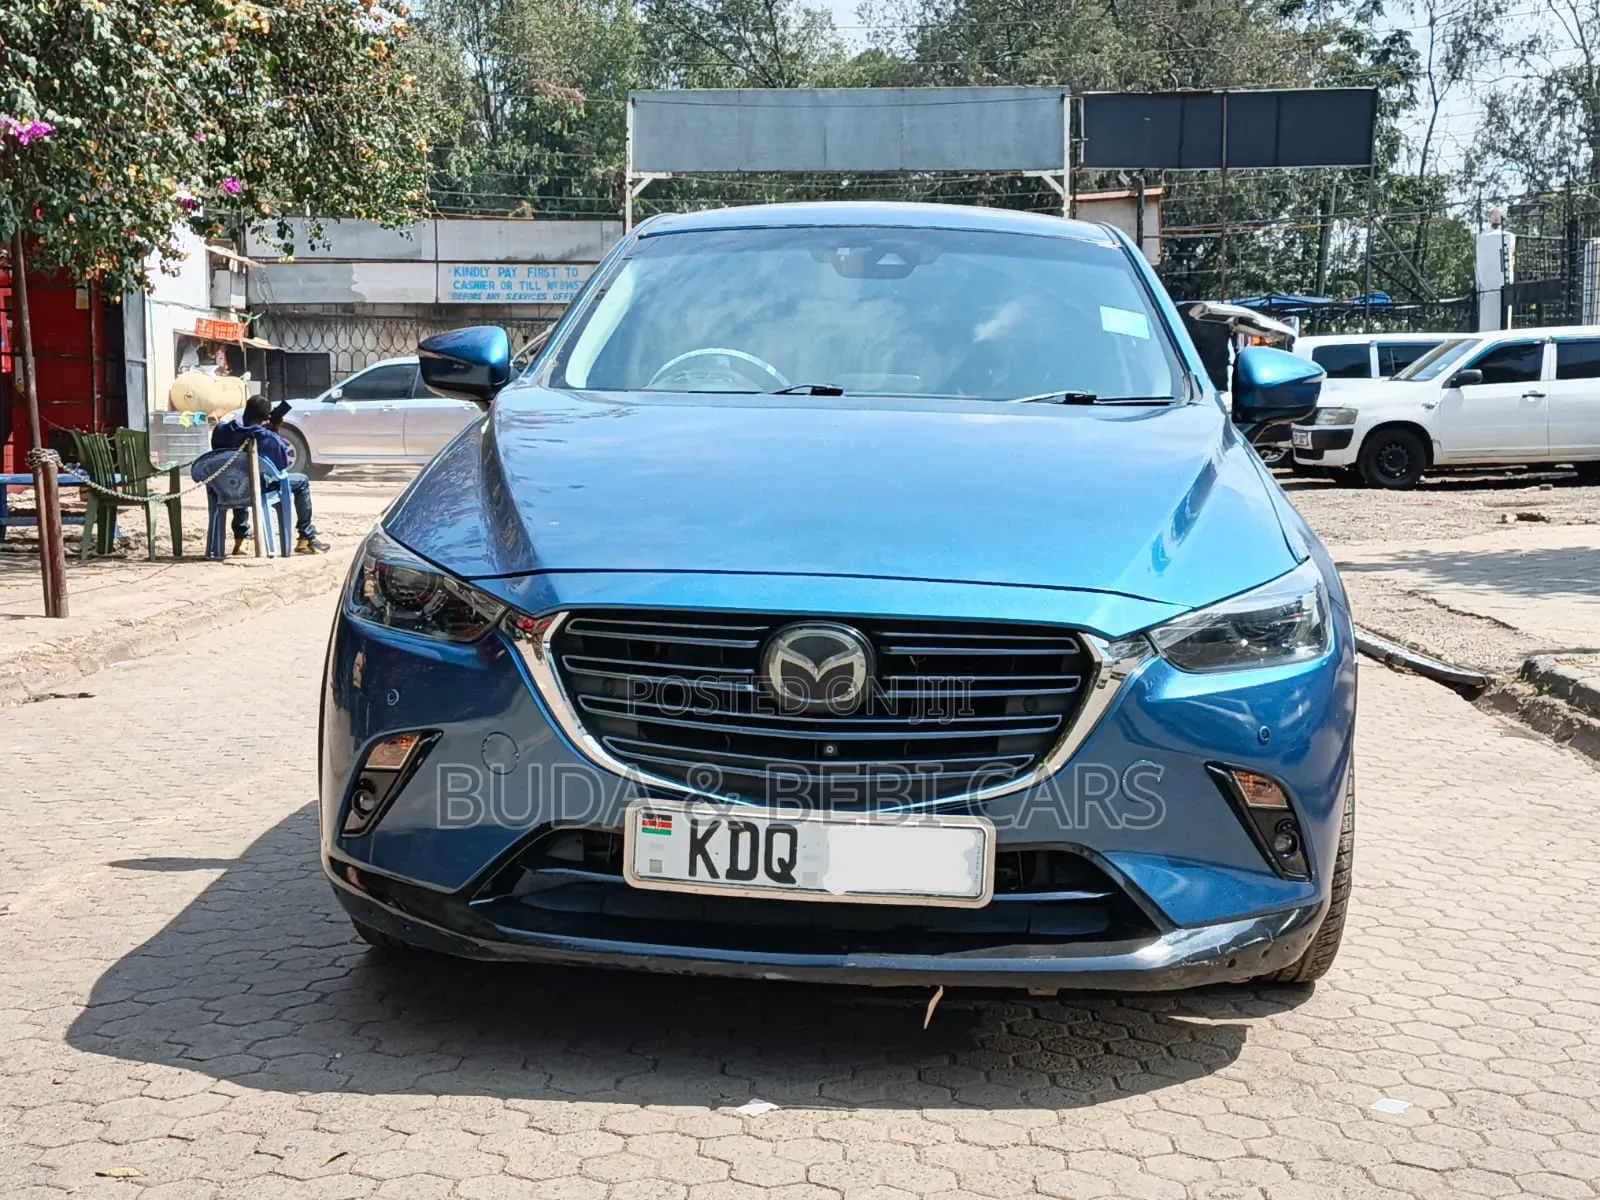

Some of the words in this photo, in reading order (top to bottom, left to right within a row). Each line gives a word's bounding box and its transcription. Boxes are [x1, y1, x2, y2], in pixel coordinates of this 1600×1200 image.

[453, 266, 490, 278] KINDLY
[498, 266, 517, 278] PAY
[527, 266, 556, 278] FIRST
[565, 266, 579, 278] TO
[453, 280, 496, 290] CASHIER
[500, 280, 513, 290] OR
[519, 280, 541, 290] TILL
[452, 292, 482, 300] BEFORE
[486, 292, 500, 300] ANY
[506, 292, 547, 300] SERVICES
[688, 818, 798, 885] KDQ
